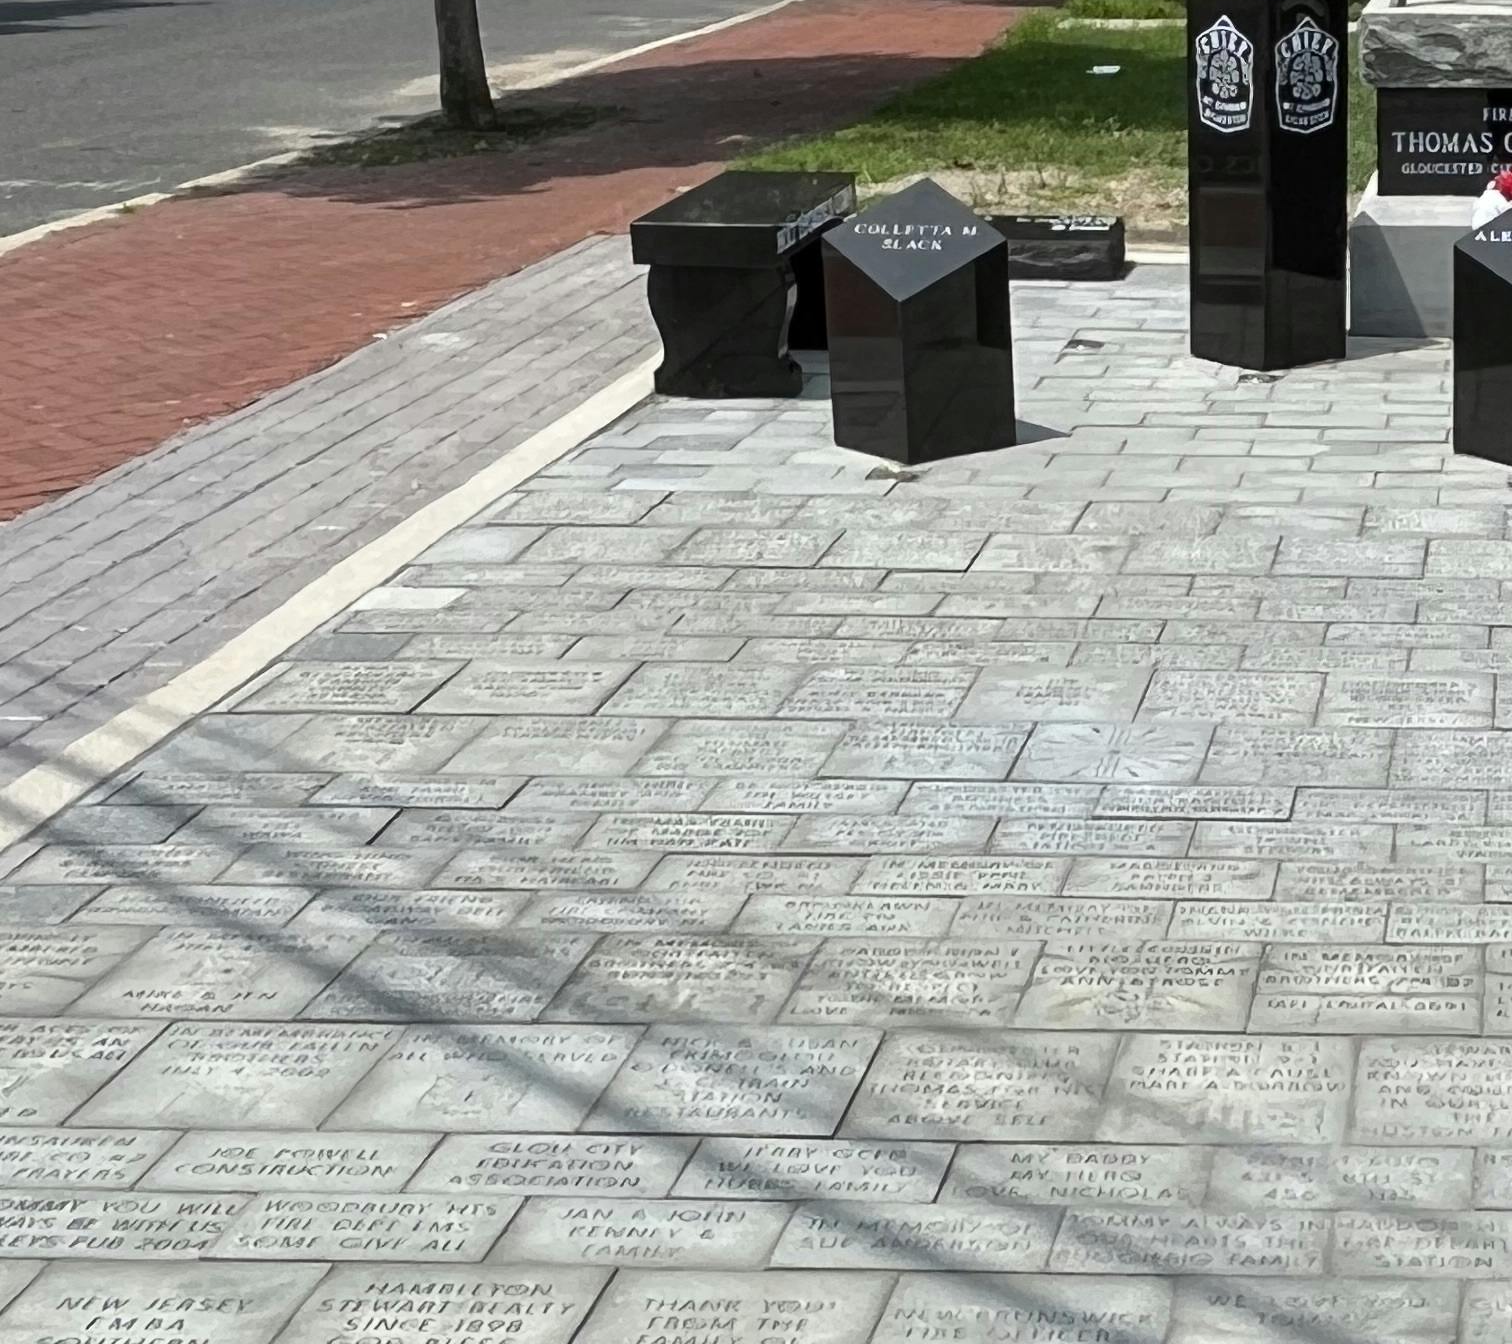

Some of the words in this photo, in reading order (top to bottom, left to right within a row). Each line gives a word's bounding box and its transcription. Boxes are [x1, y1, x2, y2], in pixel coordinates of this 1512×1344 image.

[1391, 131, 1493, 155] THOMAS
[1401, 162, 1483, 175] GLOUCESTER
[174, 1162, 400, 1178] CONSTRUCTION
[446, 1173, 642, 1189] ASSOCIATION
[102, 1199, 162, 1214] YOU
[264, 1199, 431, 1215] WOODBURY
[559, 1208, 614, 1222] JAN
[56, 1295, 130, 1312] NEW
[144, 1297, 256, 1313] JERSEY
[317, 1298, 452, 1315] STEWART
[468, 1299, 576, 1316] REALTY
[643, 1297, 743, 1313] THANK
[344, 1317, 437, 1333] SINCE
